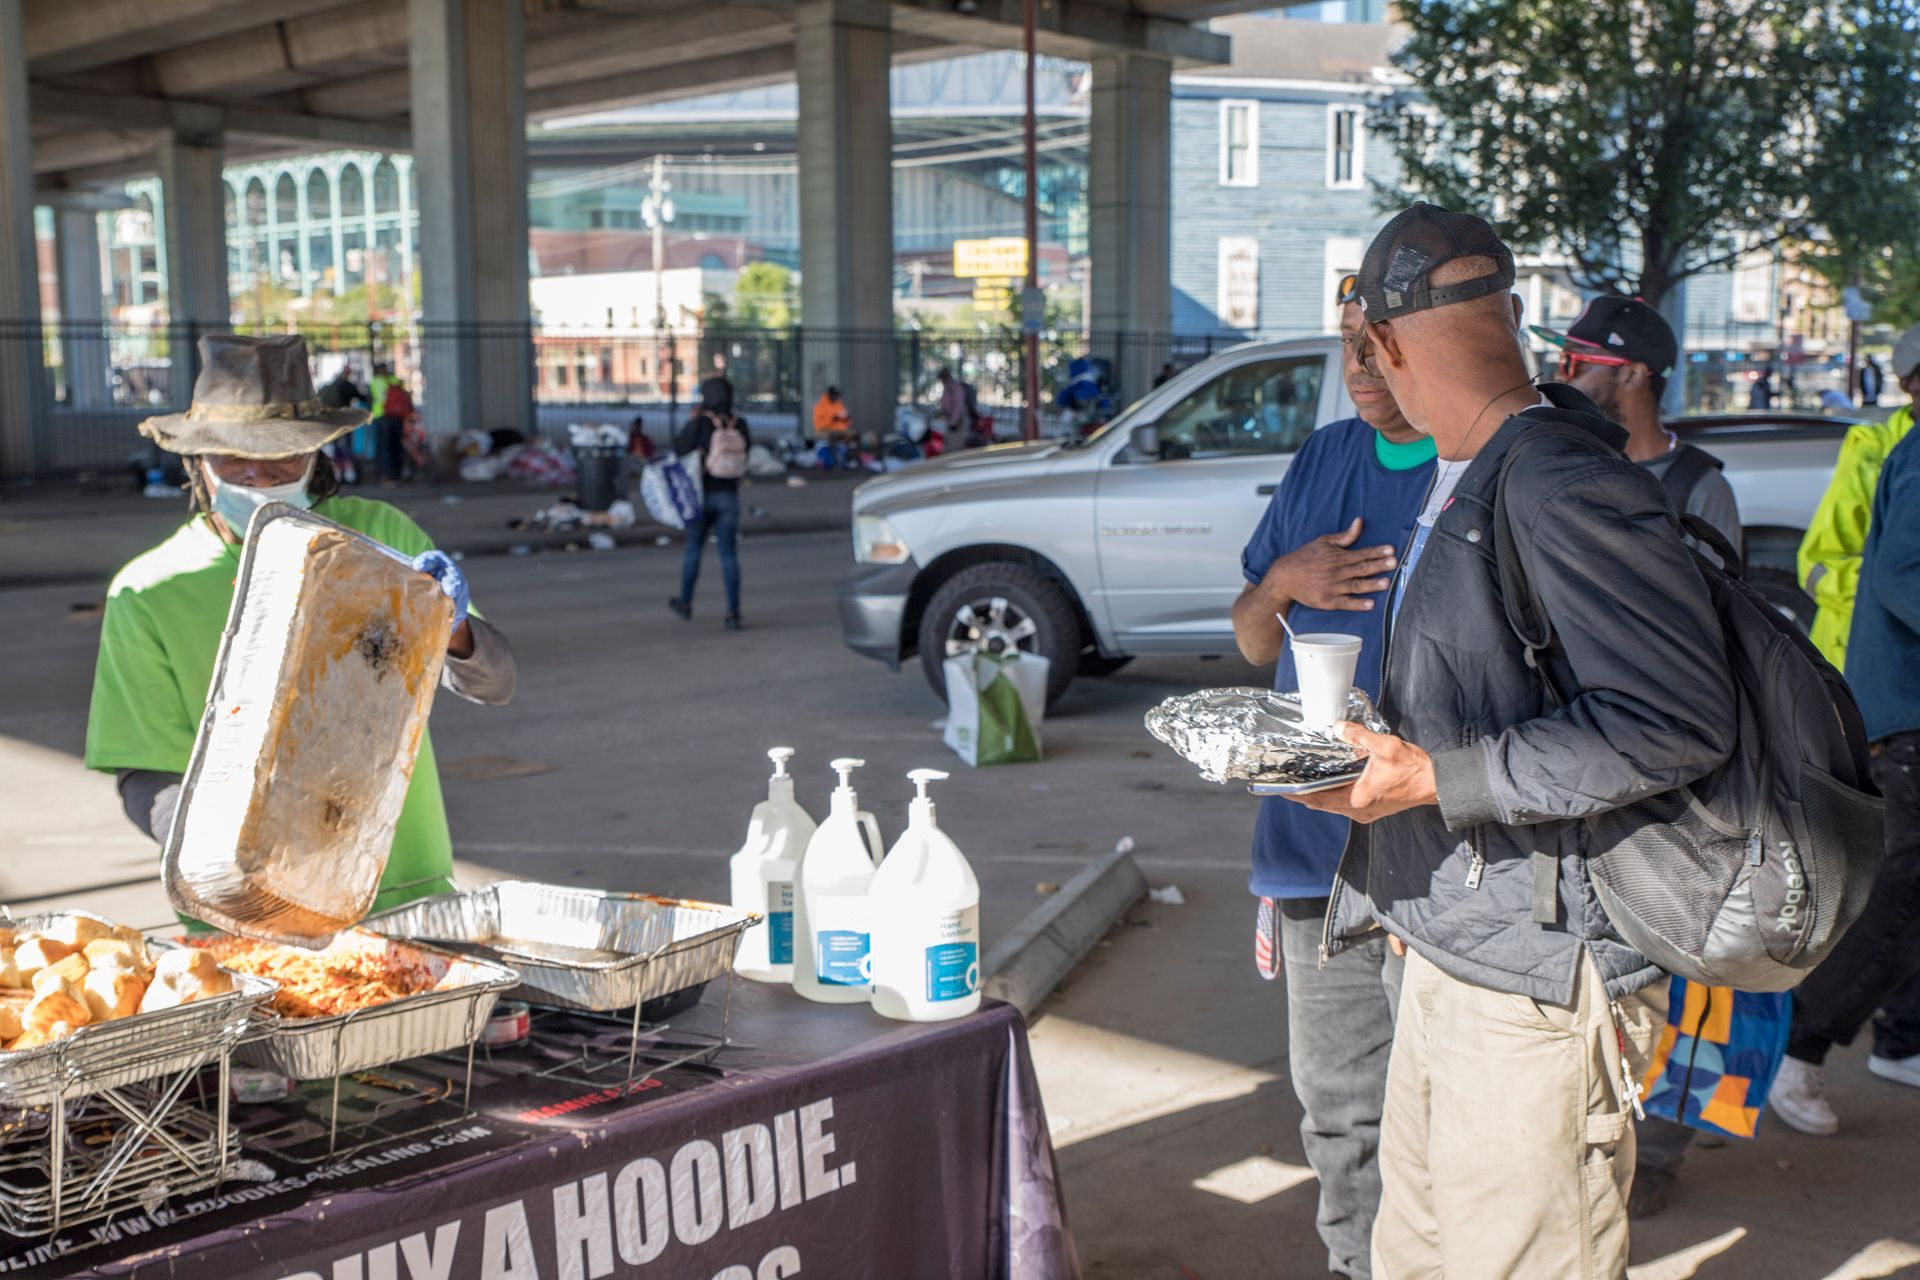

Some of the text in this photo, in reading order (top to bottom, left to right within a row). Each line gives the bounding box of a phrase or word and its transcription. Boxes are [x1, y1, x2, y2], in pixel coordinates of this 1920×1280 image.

[1774, 841, 1805, 933] Reebok
[480, 1199, 540, 1280] A
[553, 1096, 858, 1280] HOODIE.
